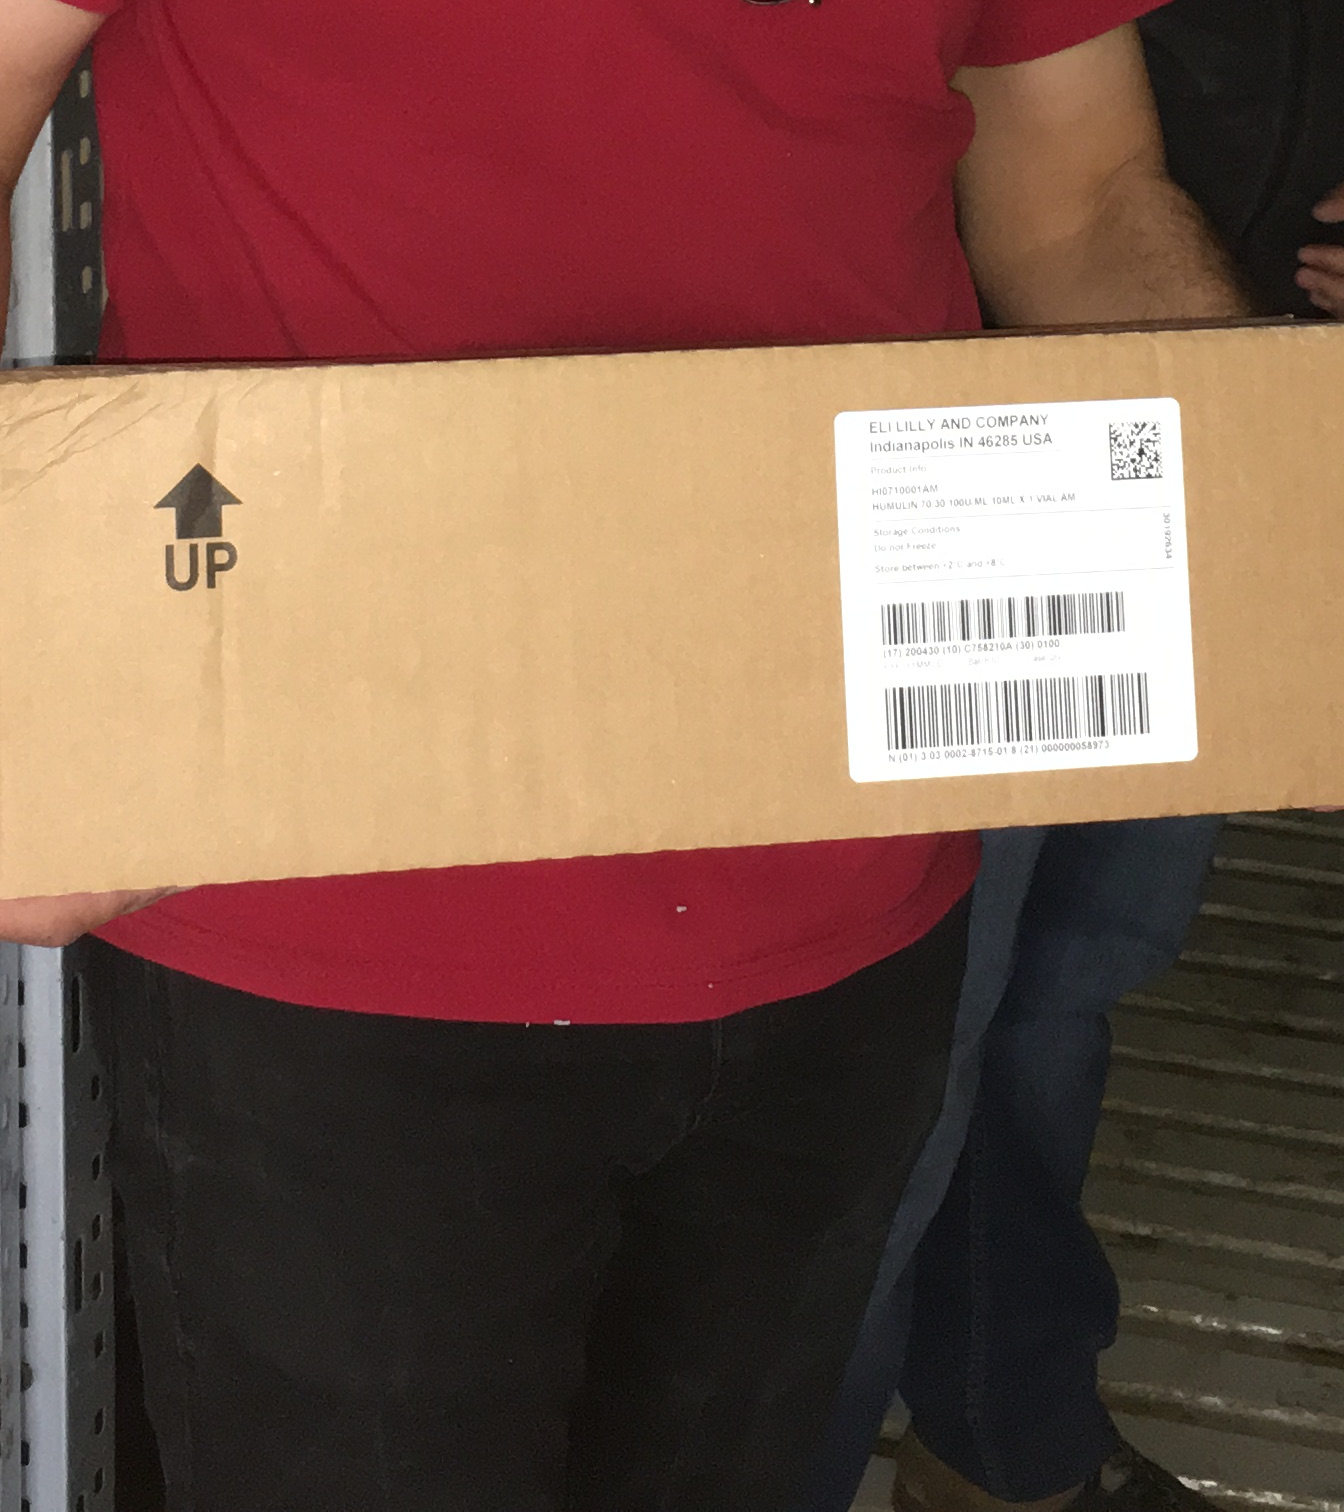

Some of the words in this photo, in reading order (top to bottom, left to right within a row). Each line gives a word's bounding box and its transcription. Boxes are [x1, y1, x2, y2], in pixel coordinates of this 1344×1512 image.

[869, 421, 892, 434] ELI
[896, 418, 936, 433] LILLY
[940, 417, 971, 430] AND
[976, 414, 1049, 429] COMPANY
[870, 437, 955, 453] Indianapolis
[959, 436, 974, 449] IN
[978, 434, 1018, 448] 46285
[1022, 432, 1053, 446] USA
[872, 500, 918, 511] HUMULIN
[992, 495, 1016, 505] 10ML
[1036, 494, 1058, 503] VIAL
[1060, 492, 1076, 502] AM
[873, 528, 908, 537] Storage
[911, 526, 961, 535] Conditions
[164, 540, 238, 592] UP
[875, 564, 900, 573] Store
[902, 562, 940, 572] between
[966, 559, 983, 568] and
[883, 648, 903, 659] (17)
[905, 646, 939, 657] 200430
[942, 645, 961, 656] (10)
[1016, 640, 1034, 651] (30)
[1037, 639, 1060, 649] 0100
[888, 753, 896, 763] N
[898, 752, 918, 764] (01)
[929, 750, 941, 761] 03
[1019, 743, 1039, 756] (21)
